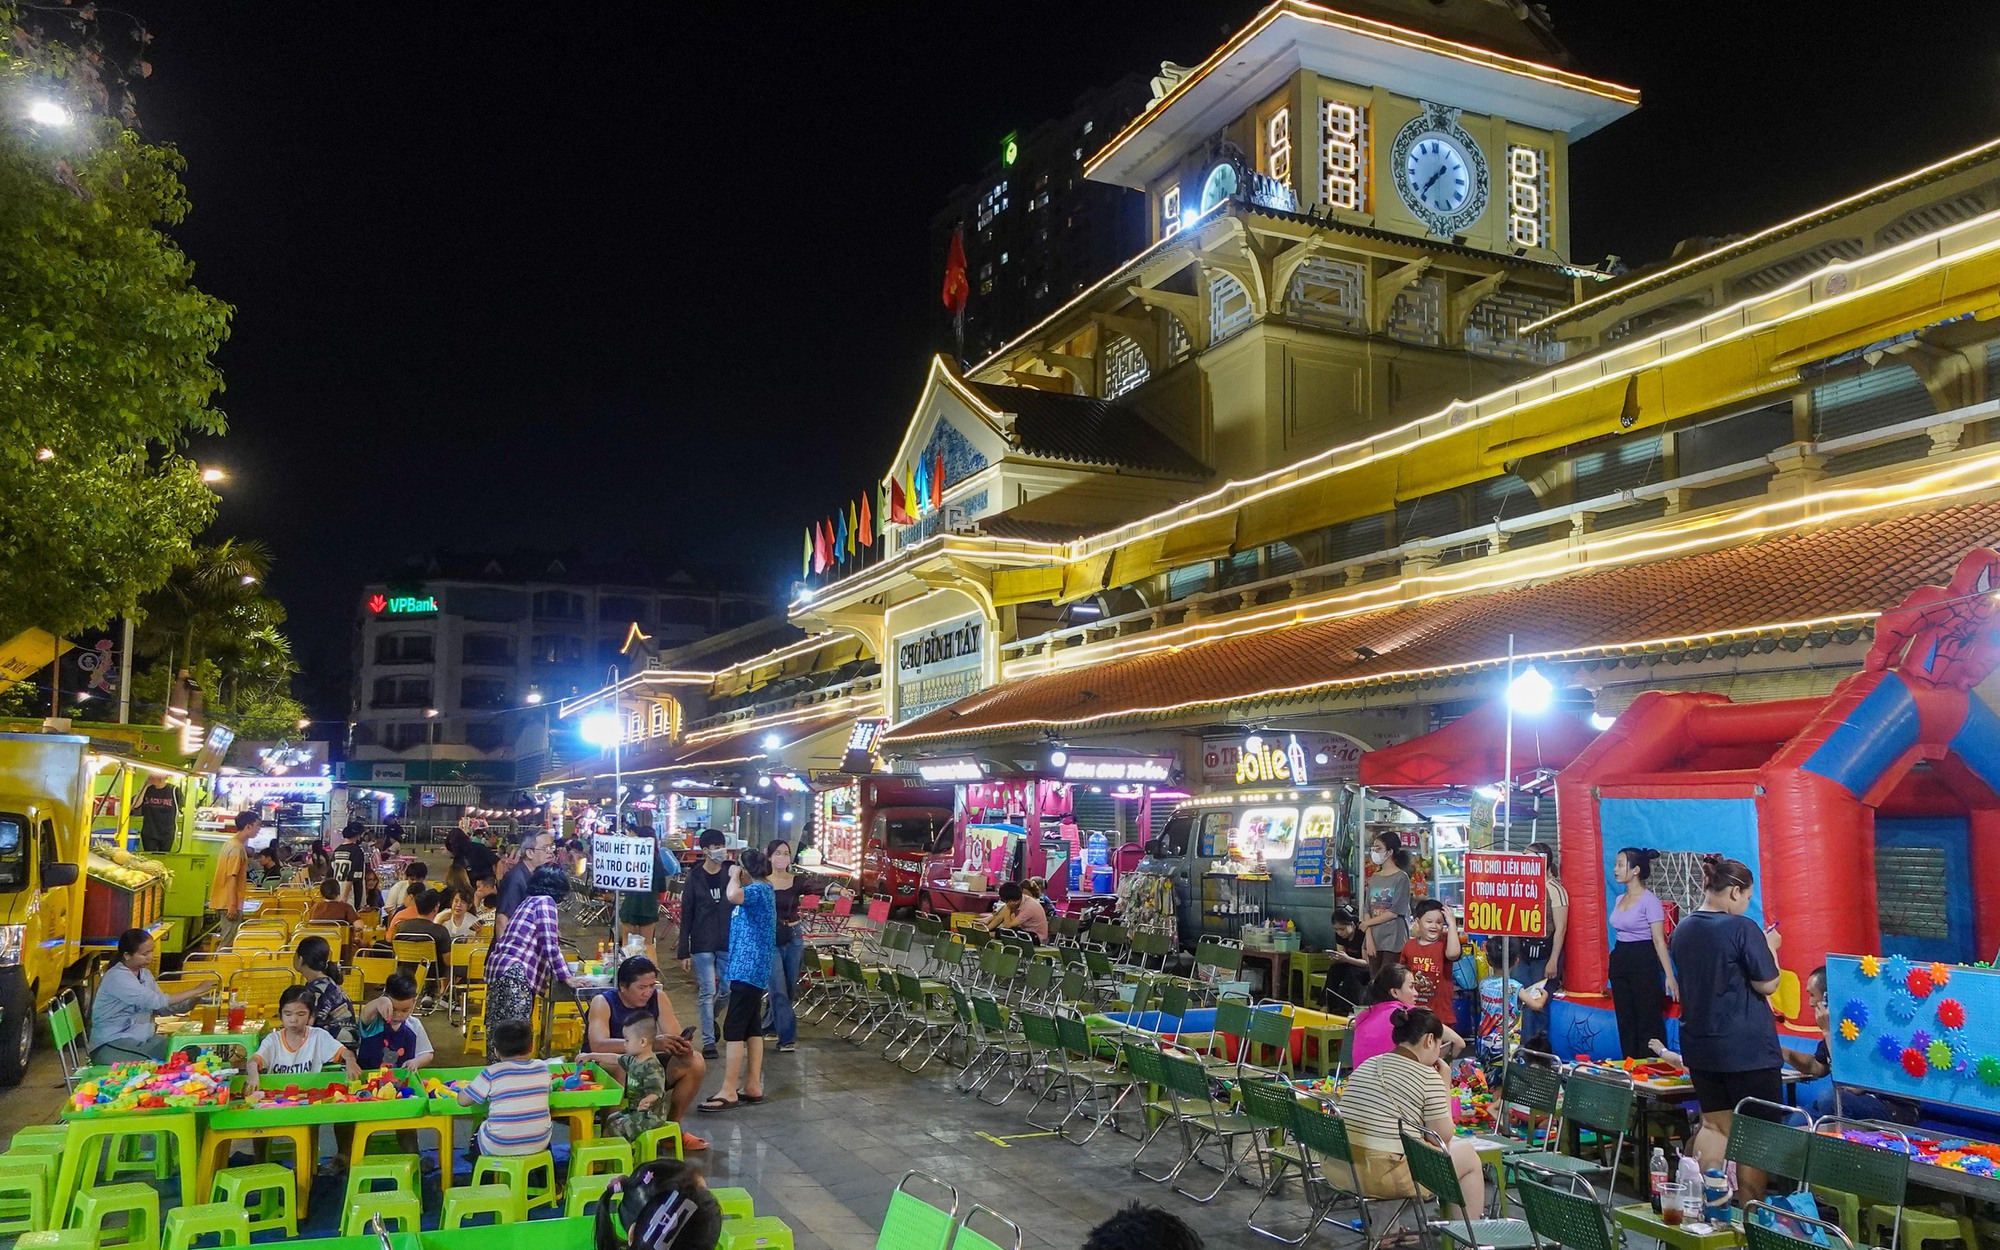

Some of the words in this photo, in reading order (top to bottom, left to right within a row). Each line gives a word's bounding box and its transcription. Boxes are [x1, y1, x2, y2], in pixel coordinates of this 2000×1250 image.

[390, 596, 439, 613] VPBank
[900, 636, 924, 674] CHỢ
[924, 629, 955, 665] BÌNH
[955, 620, 982, 657] TÂY
[595, 840, 611, 853] CHƠI
[614, 841, 631, 854] HẾT
[635, 841, 652, 855] TẤT
[607, 858, 622, 872] TRÒ
[1469, 856, 1483, 873] TRÒ
[1485, 859, 1501, 874] CHƠI
[1503, 858, 1519, 875] LIÊN
[1521, 859, 1541, 876] HOÀN
[596, 874, 650, 889] 20K/BÉ
[1476, 882, 1495, 899] TRỌN
[1497, 880, 1509, 897] GÓI
[1510, 878, 1524, 897] TẤT
[1468, 902, 1503, 931] 30k
[1520, 904, 1541, 933] vé
[1413, 956, 1435, 965] EVEL
